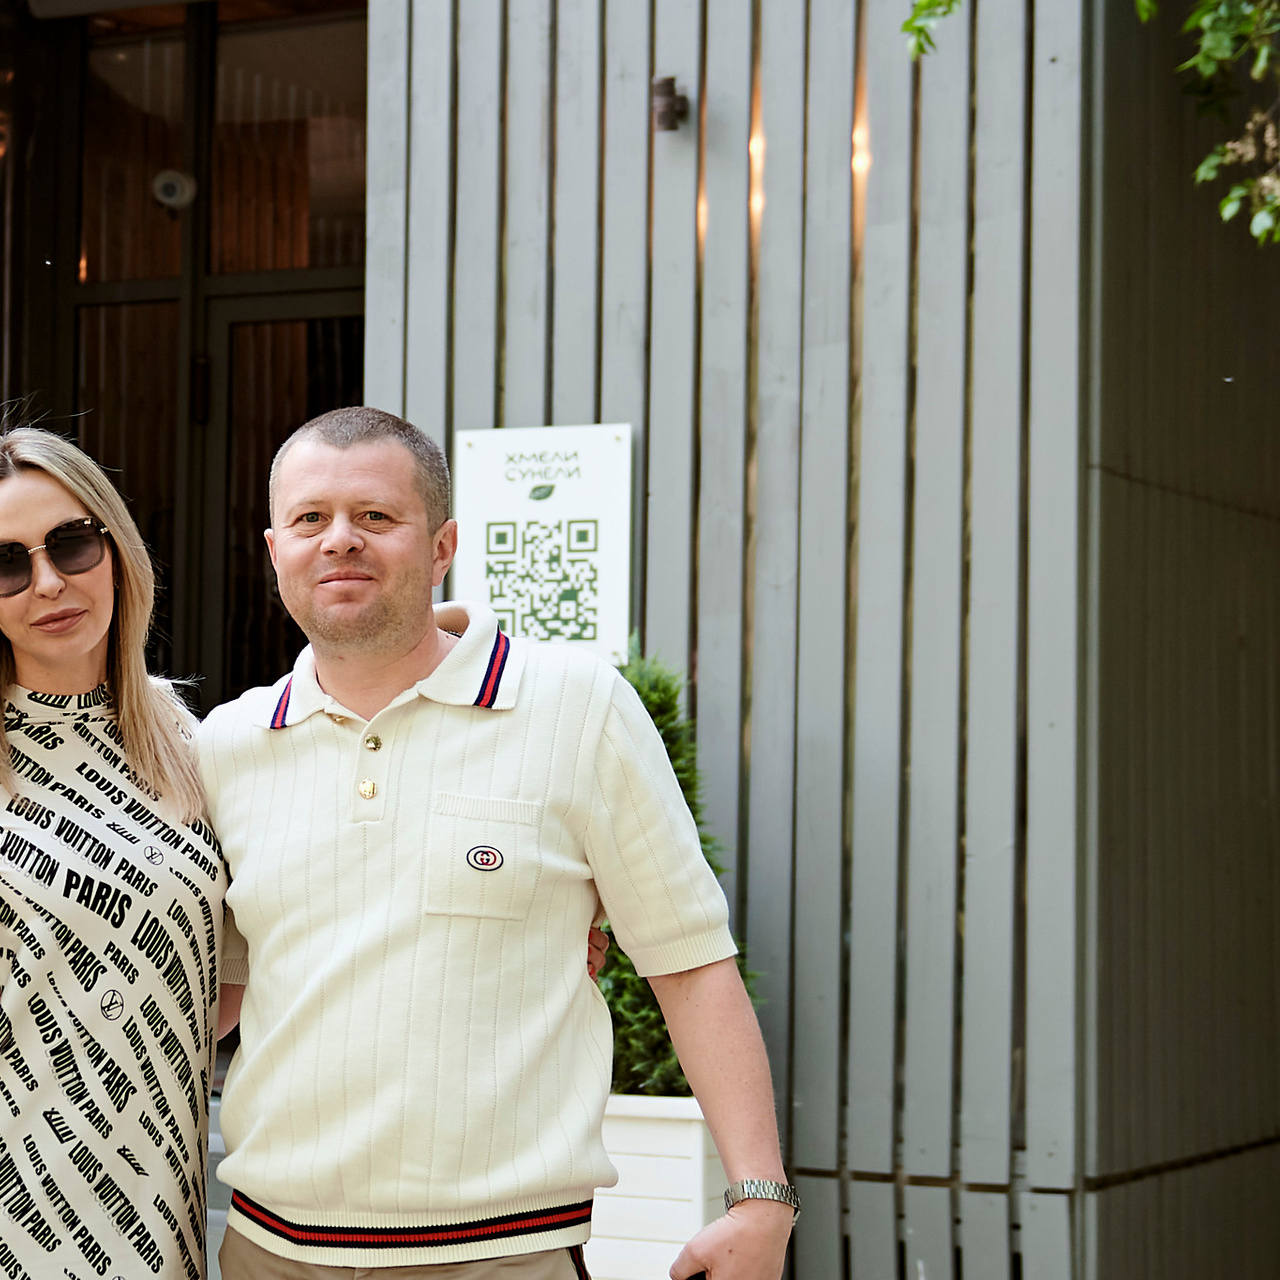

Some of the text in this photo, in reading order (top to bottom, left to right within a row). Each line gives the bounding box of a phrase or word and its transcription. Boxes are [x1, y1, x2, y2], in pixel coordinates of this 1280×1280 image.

[505, 450, 579, 464] ХМЕЛИ
[505, 466, 582, 482] СУНЕЛИ
[48, 782, 106, 819] PARIS
[75, 761, 219, 882] LOUIS VUITTON PARIS
[6, 793, 159, 897] LOUIS VUITTON PARIS
[0, 830, 61, 888] VUITTON
[62, 868, 133, 929] PARIS
[13, 918, 46, 960] PARIS
[166, 898, 194, 939] LOUIS
[63, 937, 108, 993] PARIS
[103, 940, 140, 985] PARIS
[130, 908, 175, 970] LOUIS
[161, 949, 195, 1016] VUITTON
[4, 1047, 39, 1092] PARIS
[27, 991, 113, 1140] LOUIS VUITTON PARIS
[121, 1014, 147, 1061] LOUIS
[139, 1055, 172, 1120] VUITTON
[139, 993, 169, 1038] LOUIS
[158, 1026, 193, 1090] VUITTON
[97, 1057, 138, 1114] PARIS
[138, 1110, 165, 1148] LOUIS
[20, 1209, 62, 1253] PARIS
[22, 1133, 112, 1277] LOUIS VUITTON PARIS
[67, 1140, 165, 1274] LOUIS VUITTON PARIS
